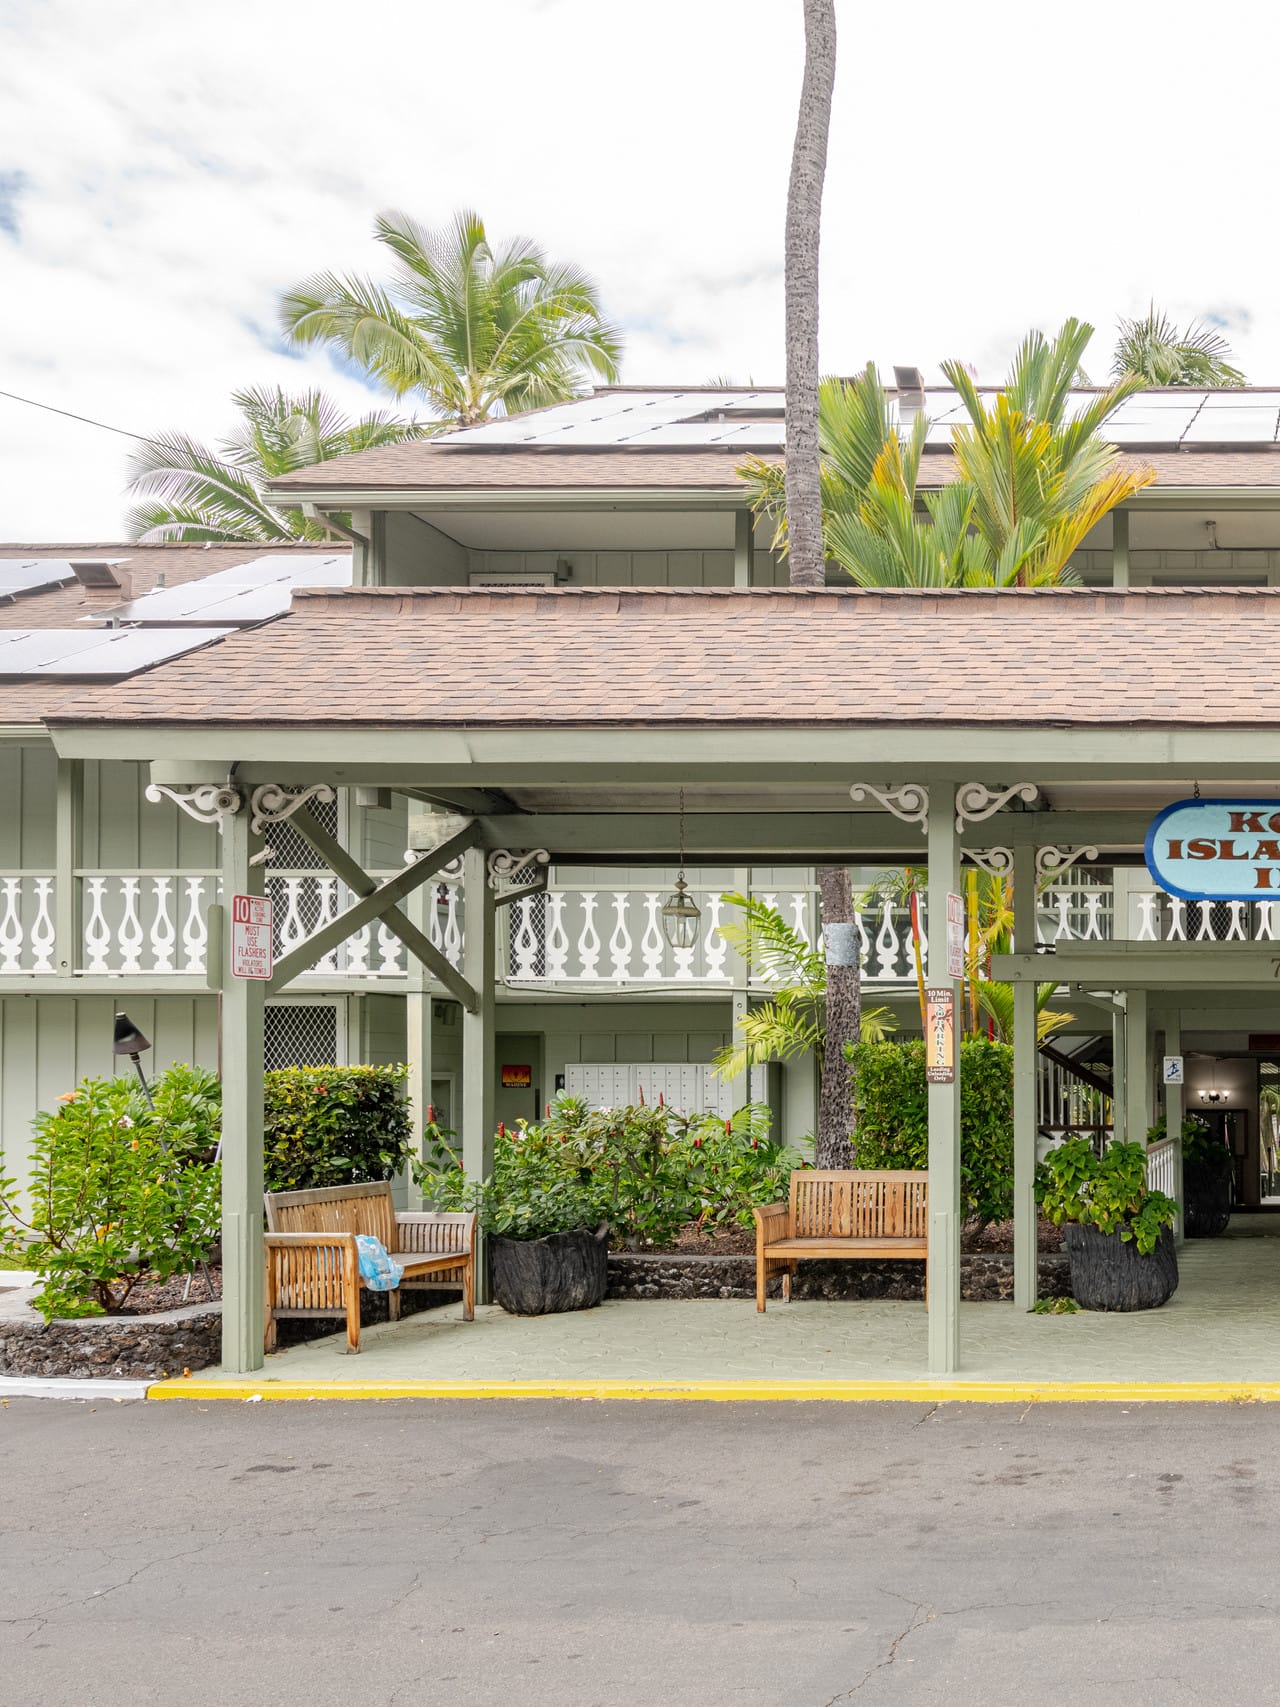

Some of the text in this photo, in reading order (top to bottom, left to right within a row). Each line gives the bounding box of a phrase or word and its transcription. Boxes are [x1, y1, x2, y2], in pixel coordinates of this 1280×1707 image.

[235, 897, 249, 921] 10
[245, 925, 260, 936] MUST
[247, 936, 258, 947] USE
[238, 946, 267, 959] FLASHERS
[935, 1004, 945, 1066] NO PARKING
